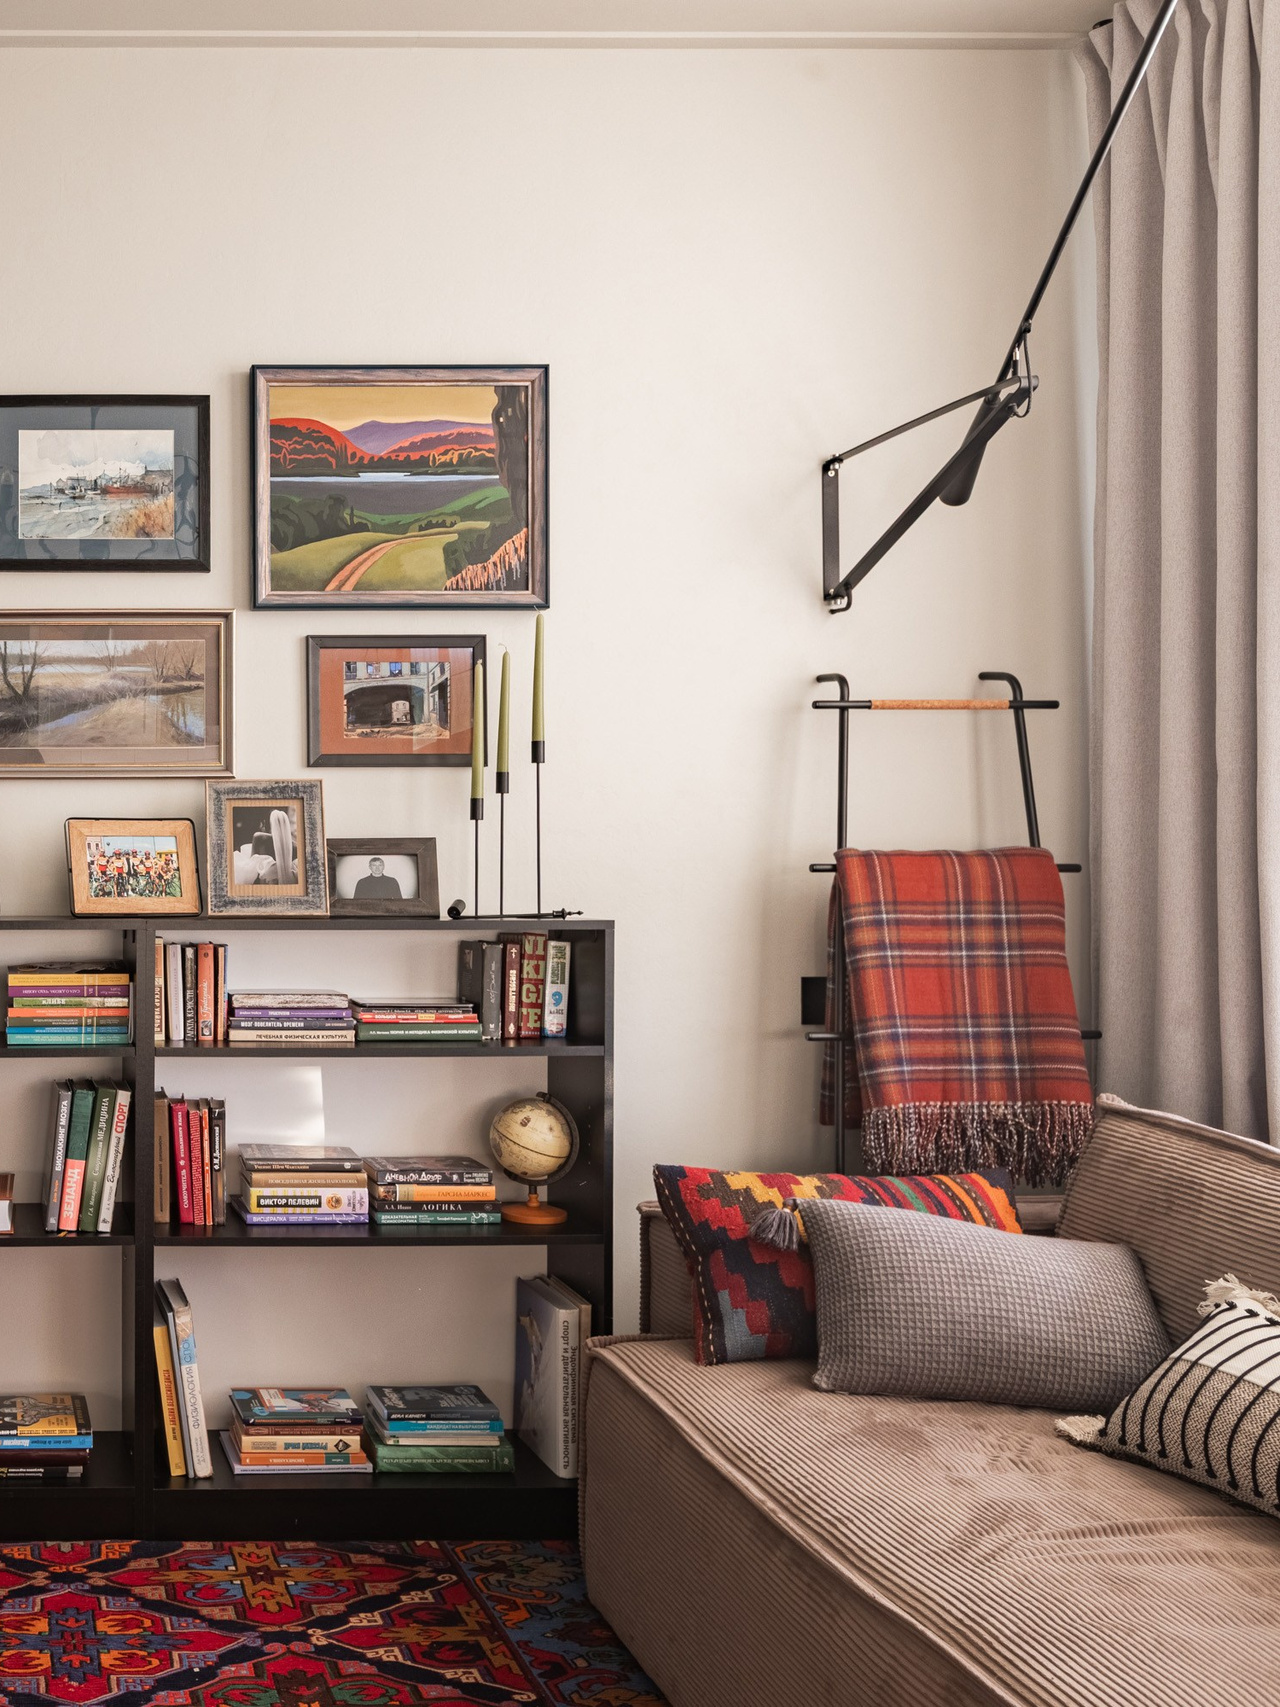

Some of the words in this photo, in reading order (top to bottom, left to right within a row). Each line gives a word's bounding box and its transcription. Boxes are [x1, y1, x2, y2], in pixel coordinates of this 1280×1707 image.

[185, 989, 194, 1017] КРИСТИ
[551, 991, 563, 1007] 9
[186, 1019, 195, 1038] АГАТА
[58, 1100, 68, 1126] МОЗГА
[97, 1098, 110, 1141] МЕДИЦИНА
[55, 1126, 66, 1171] БИОХАКИНГ
[91, 1141, 104, 1176] Спортивная
[106, 1136, 122, 1183] Велосипедный
[114, 1103, 127, 1134] СПОРТ
[63, 1169, 81, 1219] ЗЕЛАНД
[180, 1169, 189, 1208] САМОУЧИТЕЛЬ
[385, 1172, 419, 1182] ДНЕВНОЙ
[259, 1198, 287, 1206] ВИКТОР
[288, 1197, 319, 1206] ПЕЛЕВИН
[421, 1203, 462, 1211] ЛОГИКА
[561, 1320, 570, 1346] спорт
[162, 1369, 174, 1407] ВЕЛОСИПЕДИСТА
[561, 1355, 570, 1417] двигательная
[569, 1346, 578, 1406] Эндокринная
[185, 1366, 201, 1430] ФИЗИОЛОГИЯ
[167, 1408, 176, 1426] БИБЛИЯ
[302, 1442, 328, 1451] Русский
[562, 1418, 570, 1470] активность
